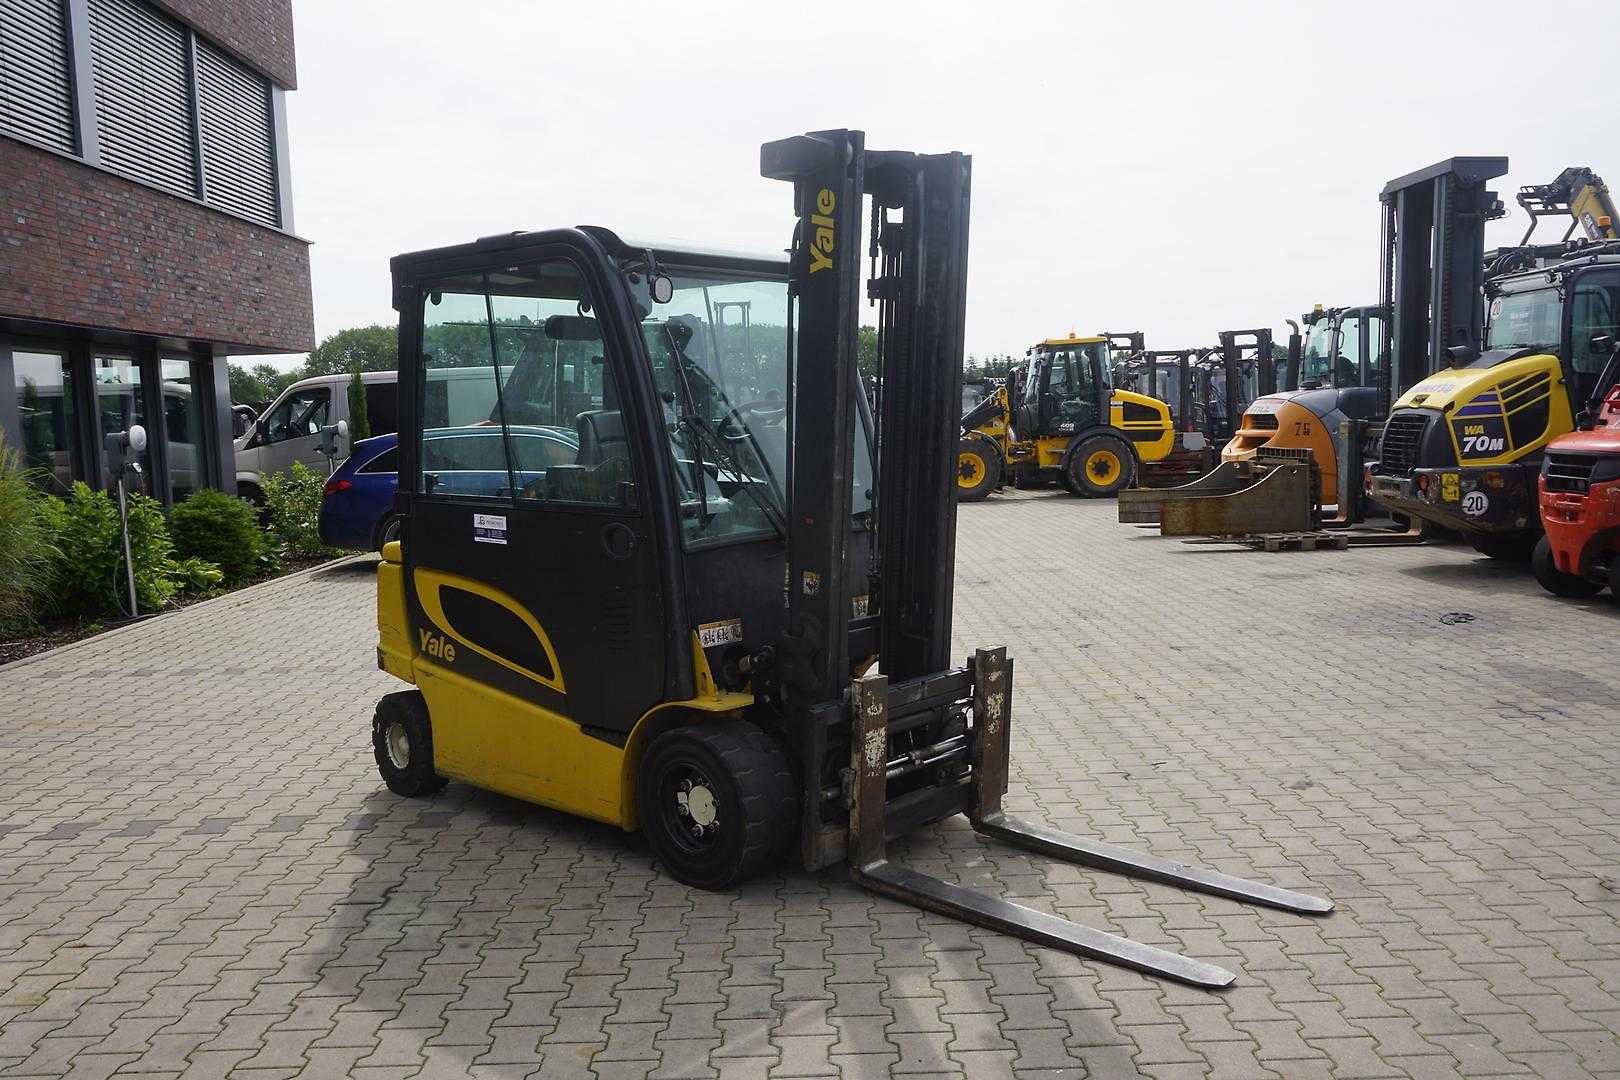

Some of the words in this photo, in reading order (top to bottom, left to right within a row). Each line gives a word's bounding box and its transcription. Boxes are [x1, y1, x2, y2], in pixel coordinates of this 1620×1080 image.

[809, 188, 836, 273] Yale
[1464, 425, 1484, 435] WA
[1463, 436, 1504, 452] 70M
[1467, 496, 1483, 511] 20
[419, 628, 456, 662] Yale
